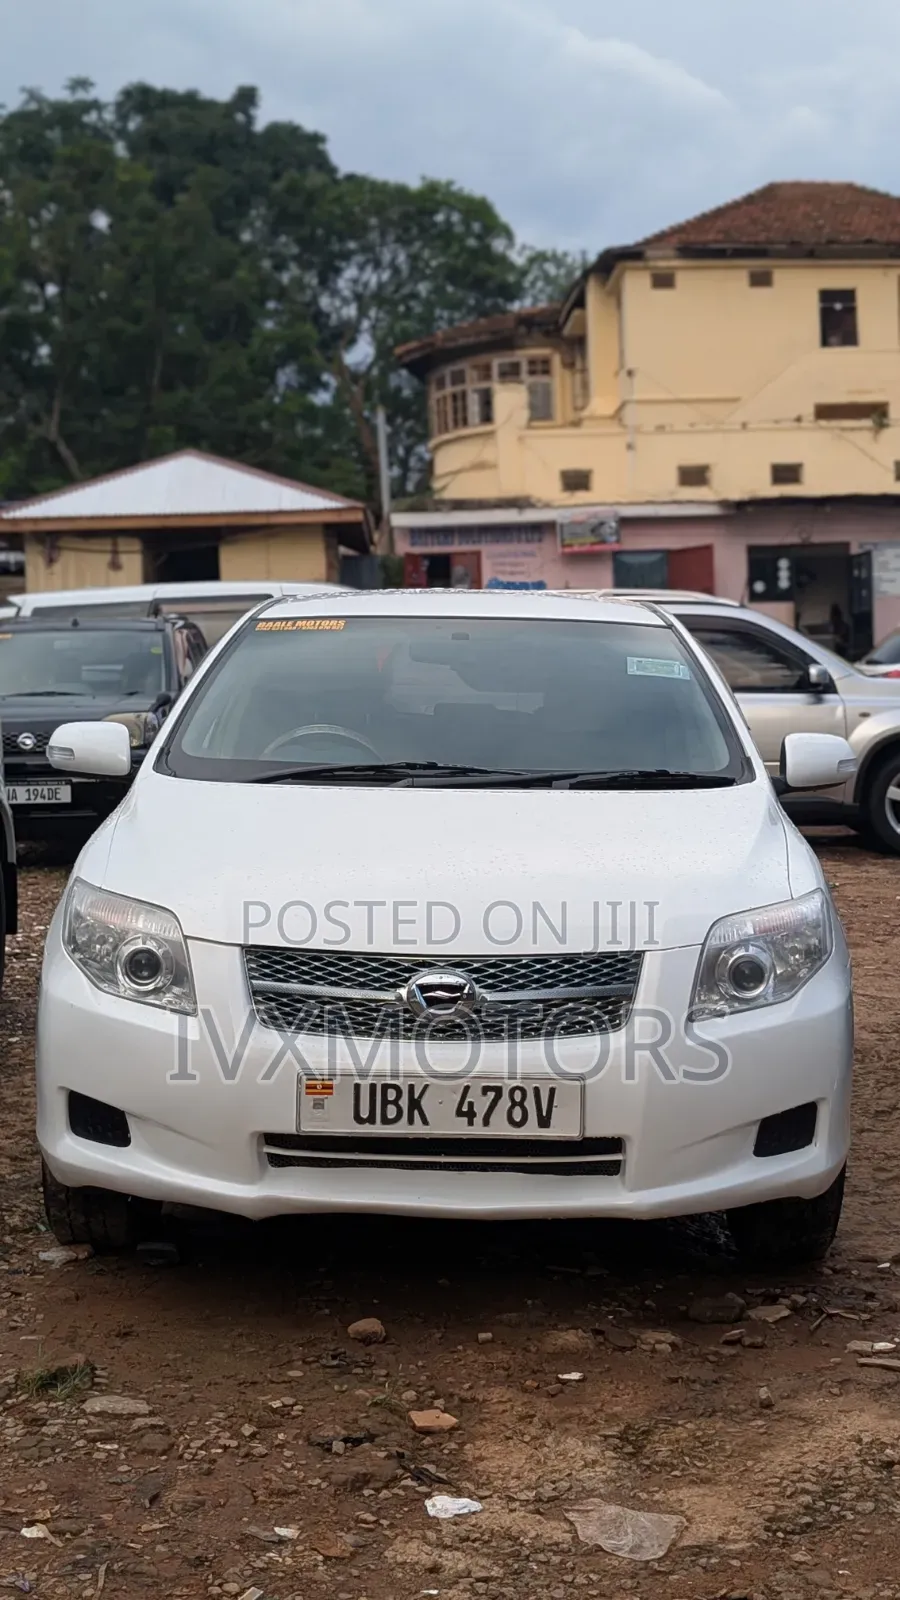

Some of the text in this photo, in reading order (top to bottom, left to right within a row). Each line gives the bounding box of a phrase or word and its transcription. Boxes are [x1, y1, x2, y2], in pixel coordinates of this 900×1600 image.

[295, 620, 346, 628] MOTORS
[25, 787, 61, 801] 194DE
[353, 1082, 557, 1128] UBK 478V
